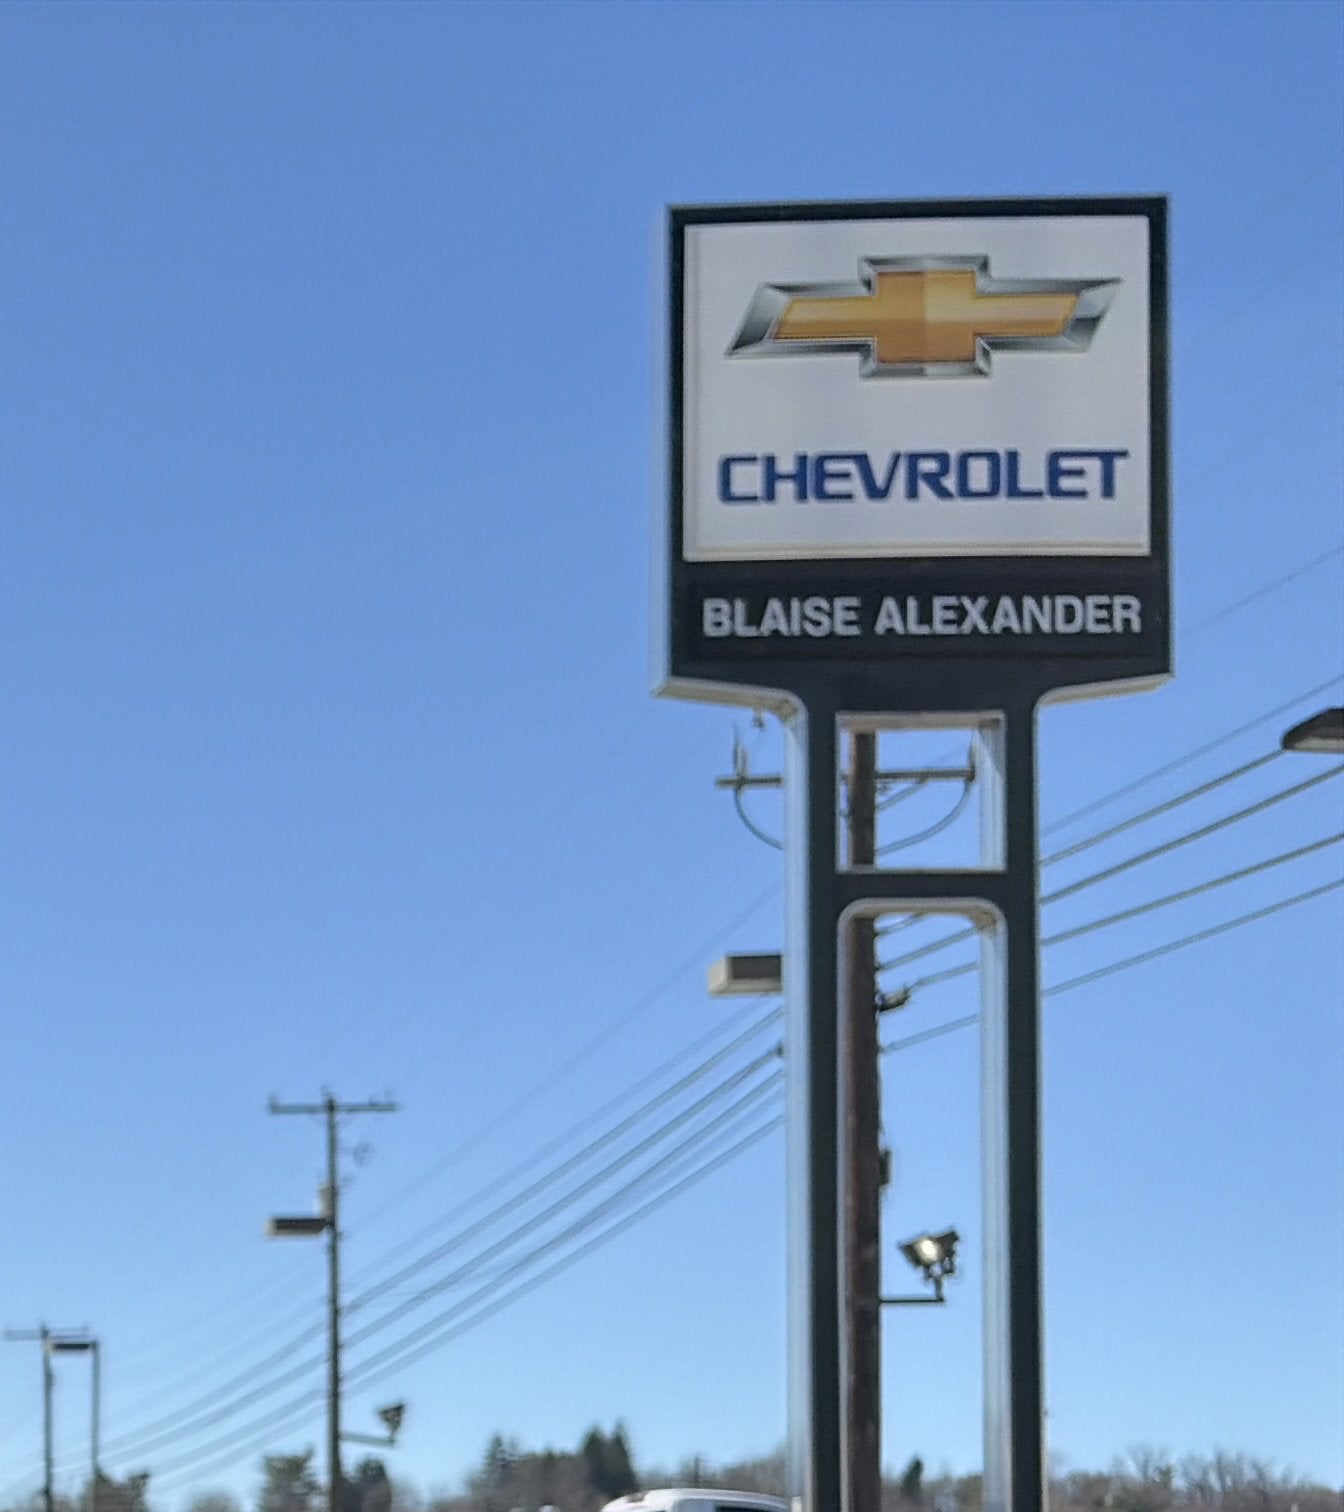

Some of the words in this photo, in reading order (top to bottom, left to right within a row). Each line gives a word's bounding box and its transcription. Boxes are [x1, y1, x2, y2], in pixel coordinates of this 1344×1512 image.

[720, 449, 1128, 502] CHEVROLET
[702, 595, 861, 636] BLAISE
[873, 595, 1143, 635] ALEXANDER
